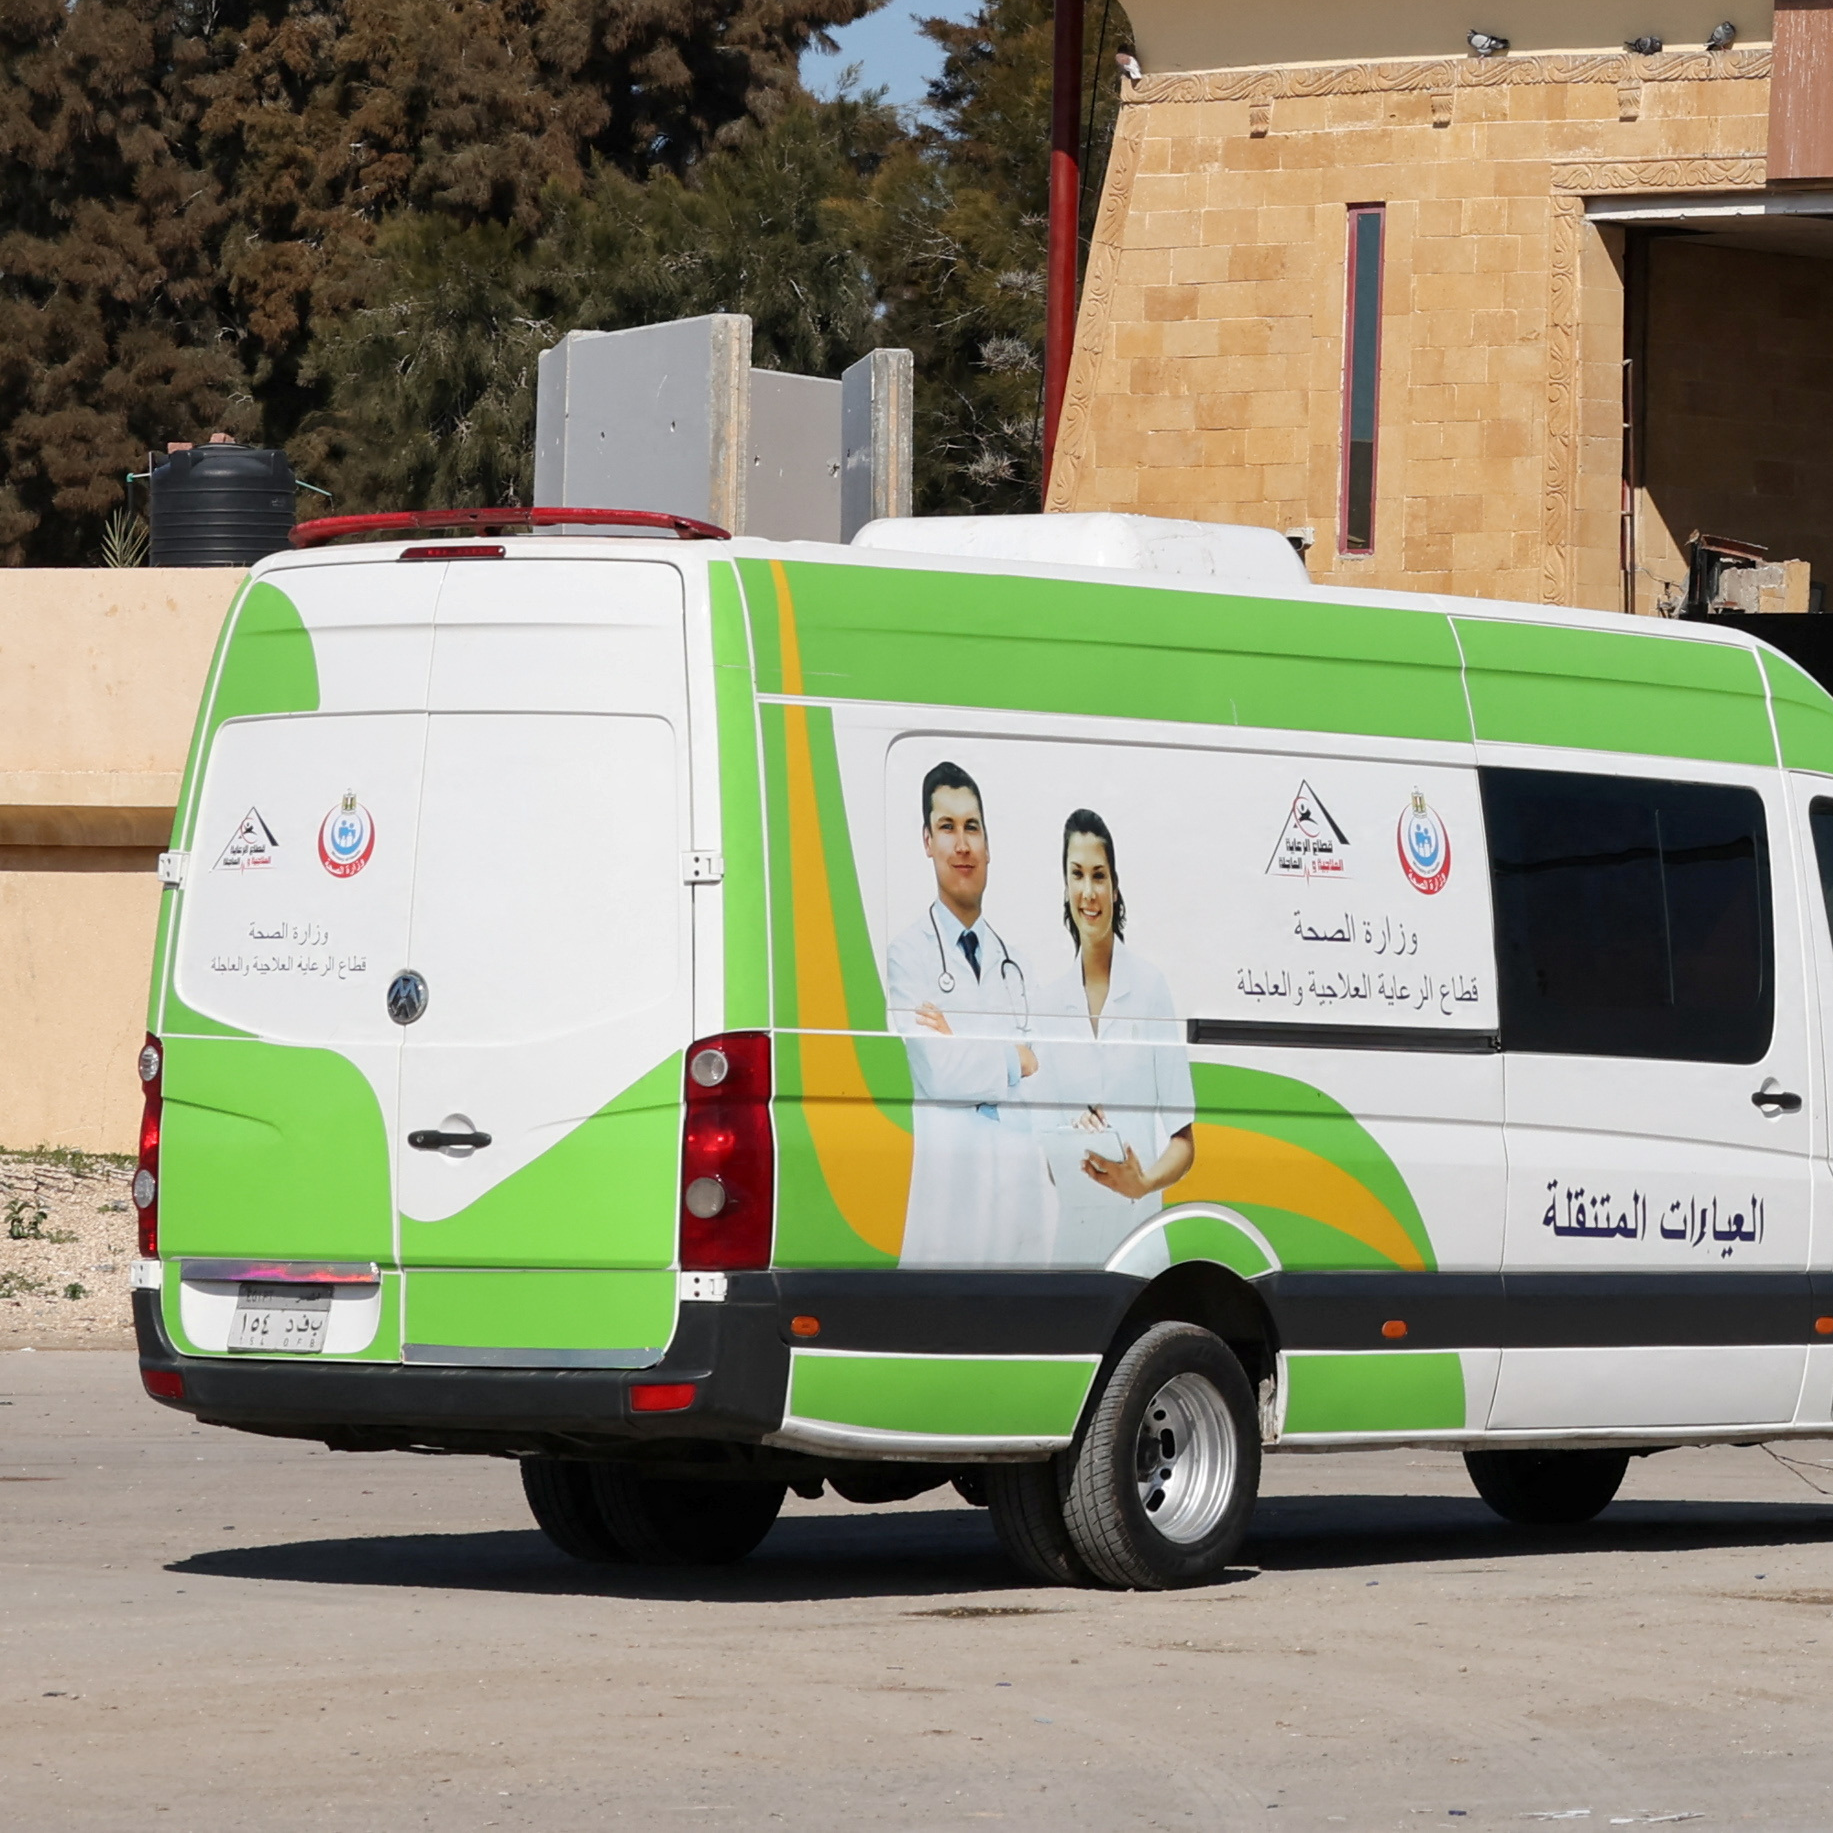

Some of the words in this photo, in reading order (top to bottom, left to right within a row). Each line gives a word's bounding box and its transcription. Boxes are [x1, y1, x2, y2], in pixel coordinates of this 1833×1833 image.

[249, 921, 289, 940] الصحة
[292, 922, 329, 946] وزارة
[1294, 910, 1356, 943] الصحة
[1362, 915, 1418, 955] وزارة
[252, 955, 293, 976] العلاجية
[338, 956, 367, 979] قطاع
[1308, 970, 1372, 1006] العلاجية
[1377, 972, 1433, 1010] الرعاية
[1439, 975, 1479, 1016] قطاع
[1541, 1178, 1647, 1242] المتنقلة
[241, 1313, 271, 1335] ١٥٤
